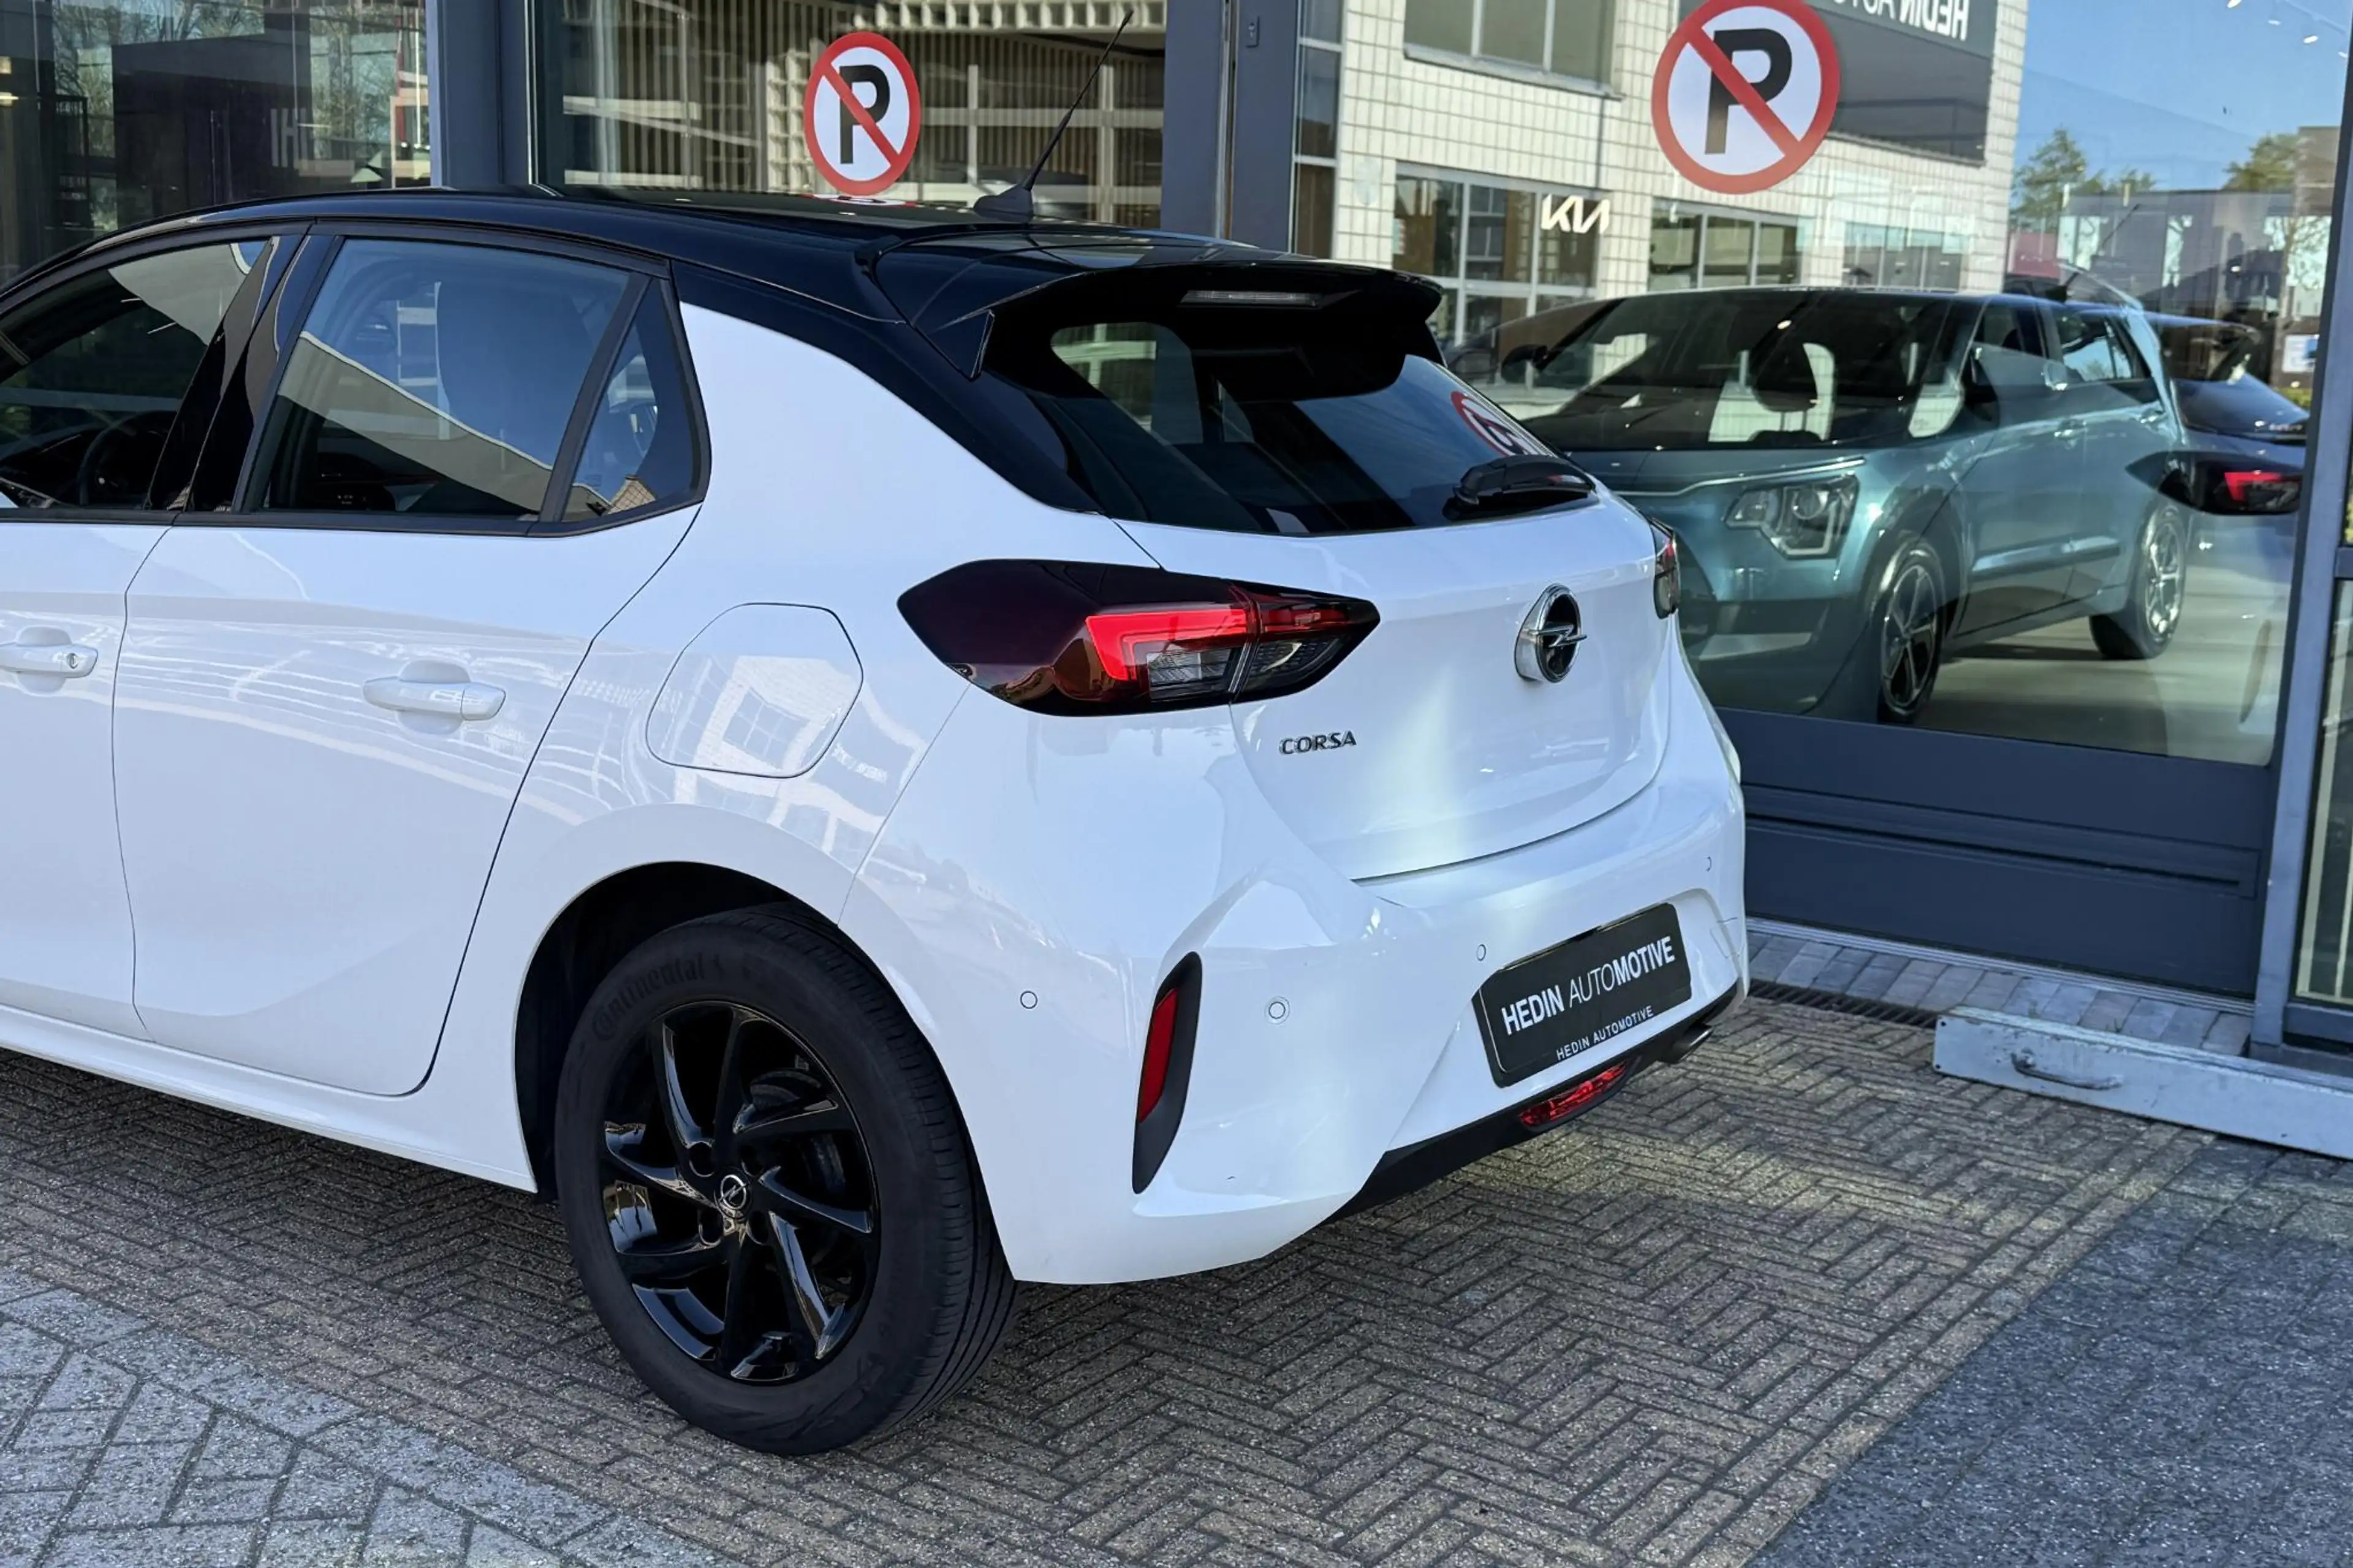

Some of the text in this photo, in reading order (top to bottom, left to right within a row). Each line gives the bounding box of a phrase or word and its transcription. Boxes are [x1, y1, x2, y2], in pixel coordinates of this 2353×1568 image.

[839, 64, 890, 164] P
[1705, 28, 1792, 154] P
[1279, 730, 1357, 754] CORSA
[593, 952, 705, 1041] Continental
[1501, 936, 1675, 1036] HEDIN AUTOMOTIVE
[1556, 1005, 1654, 1061] HEDIN AUTOMOTIVE
